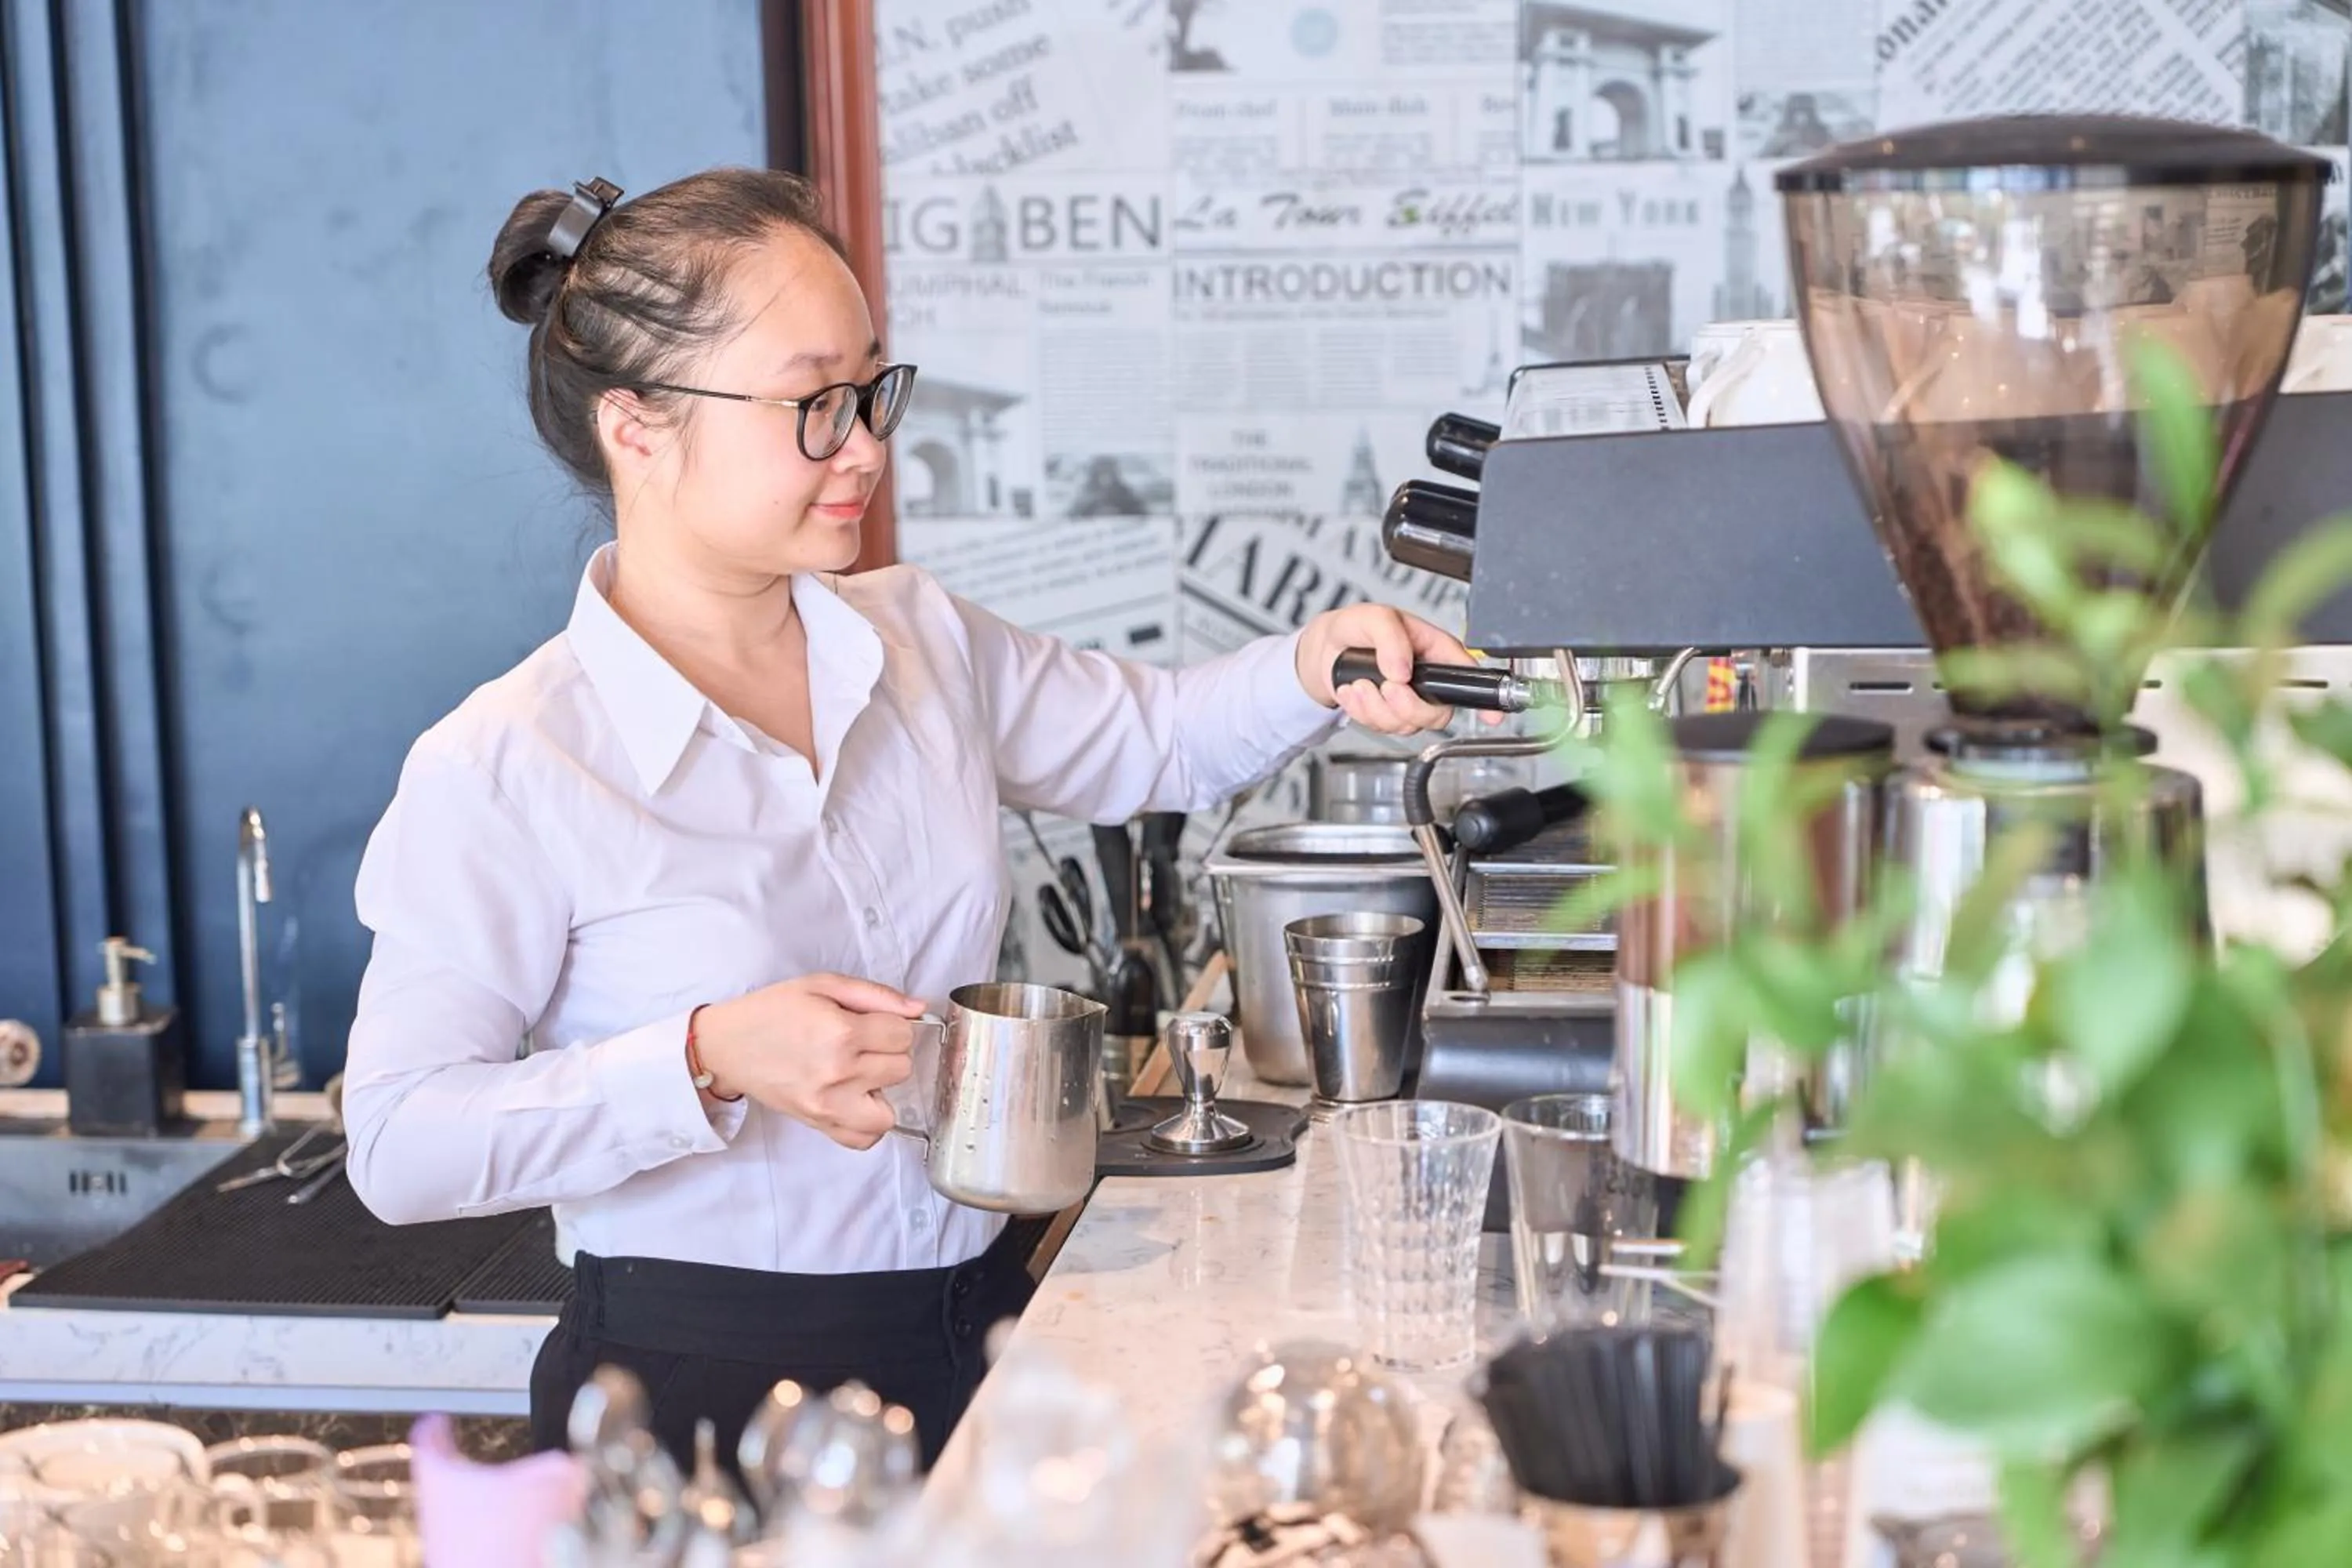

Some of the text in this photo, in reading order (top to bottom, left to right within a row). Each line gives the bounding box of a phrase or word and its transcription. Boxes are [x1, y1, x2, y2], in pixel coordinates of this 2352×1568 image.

[1020, 194, 1162, 252] BEN
[1173, 194, 1240, 230] La
[1175, 261, 1512, 301] INTRODUCTION
